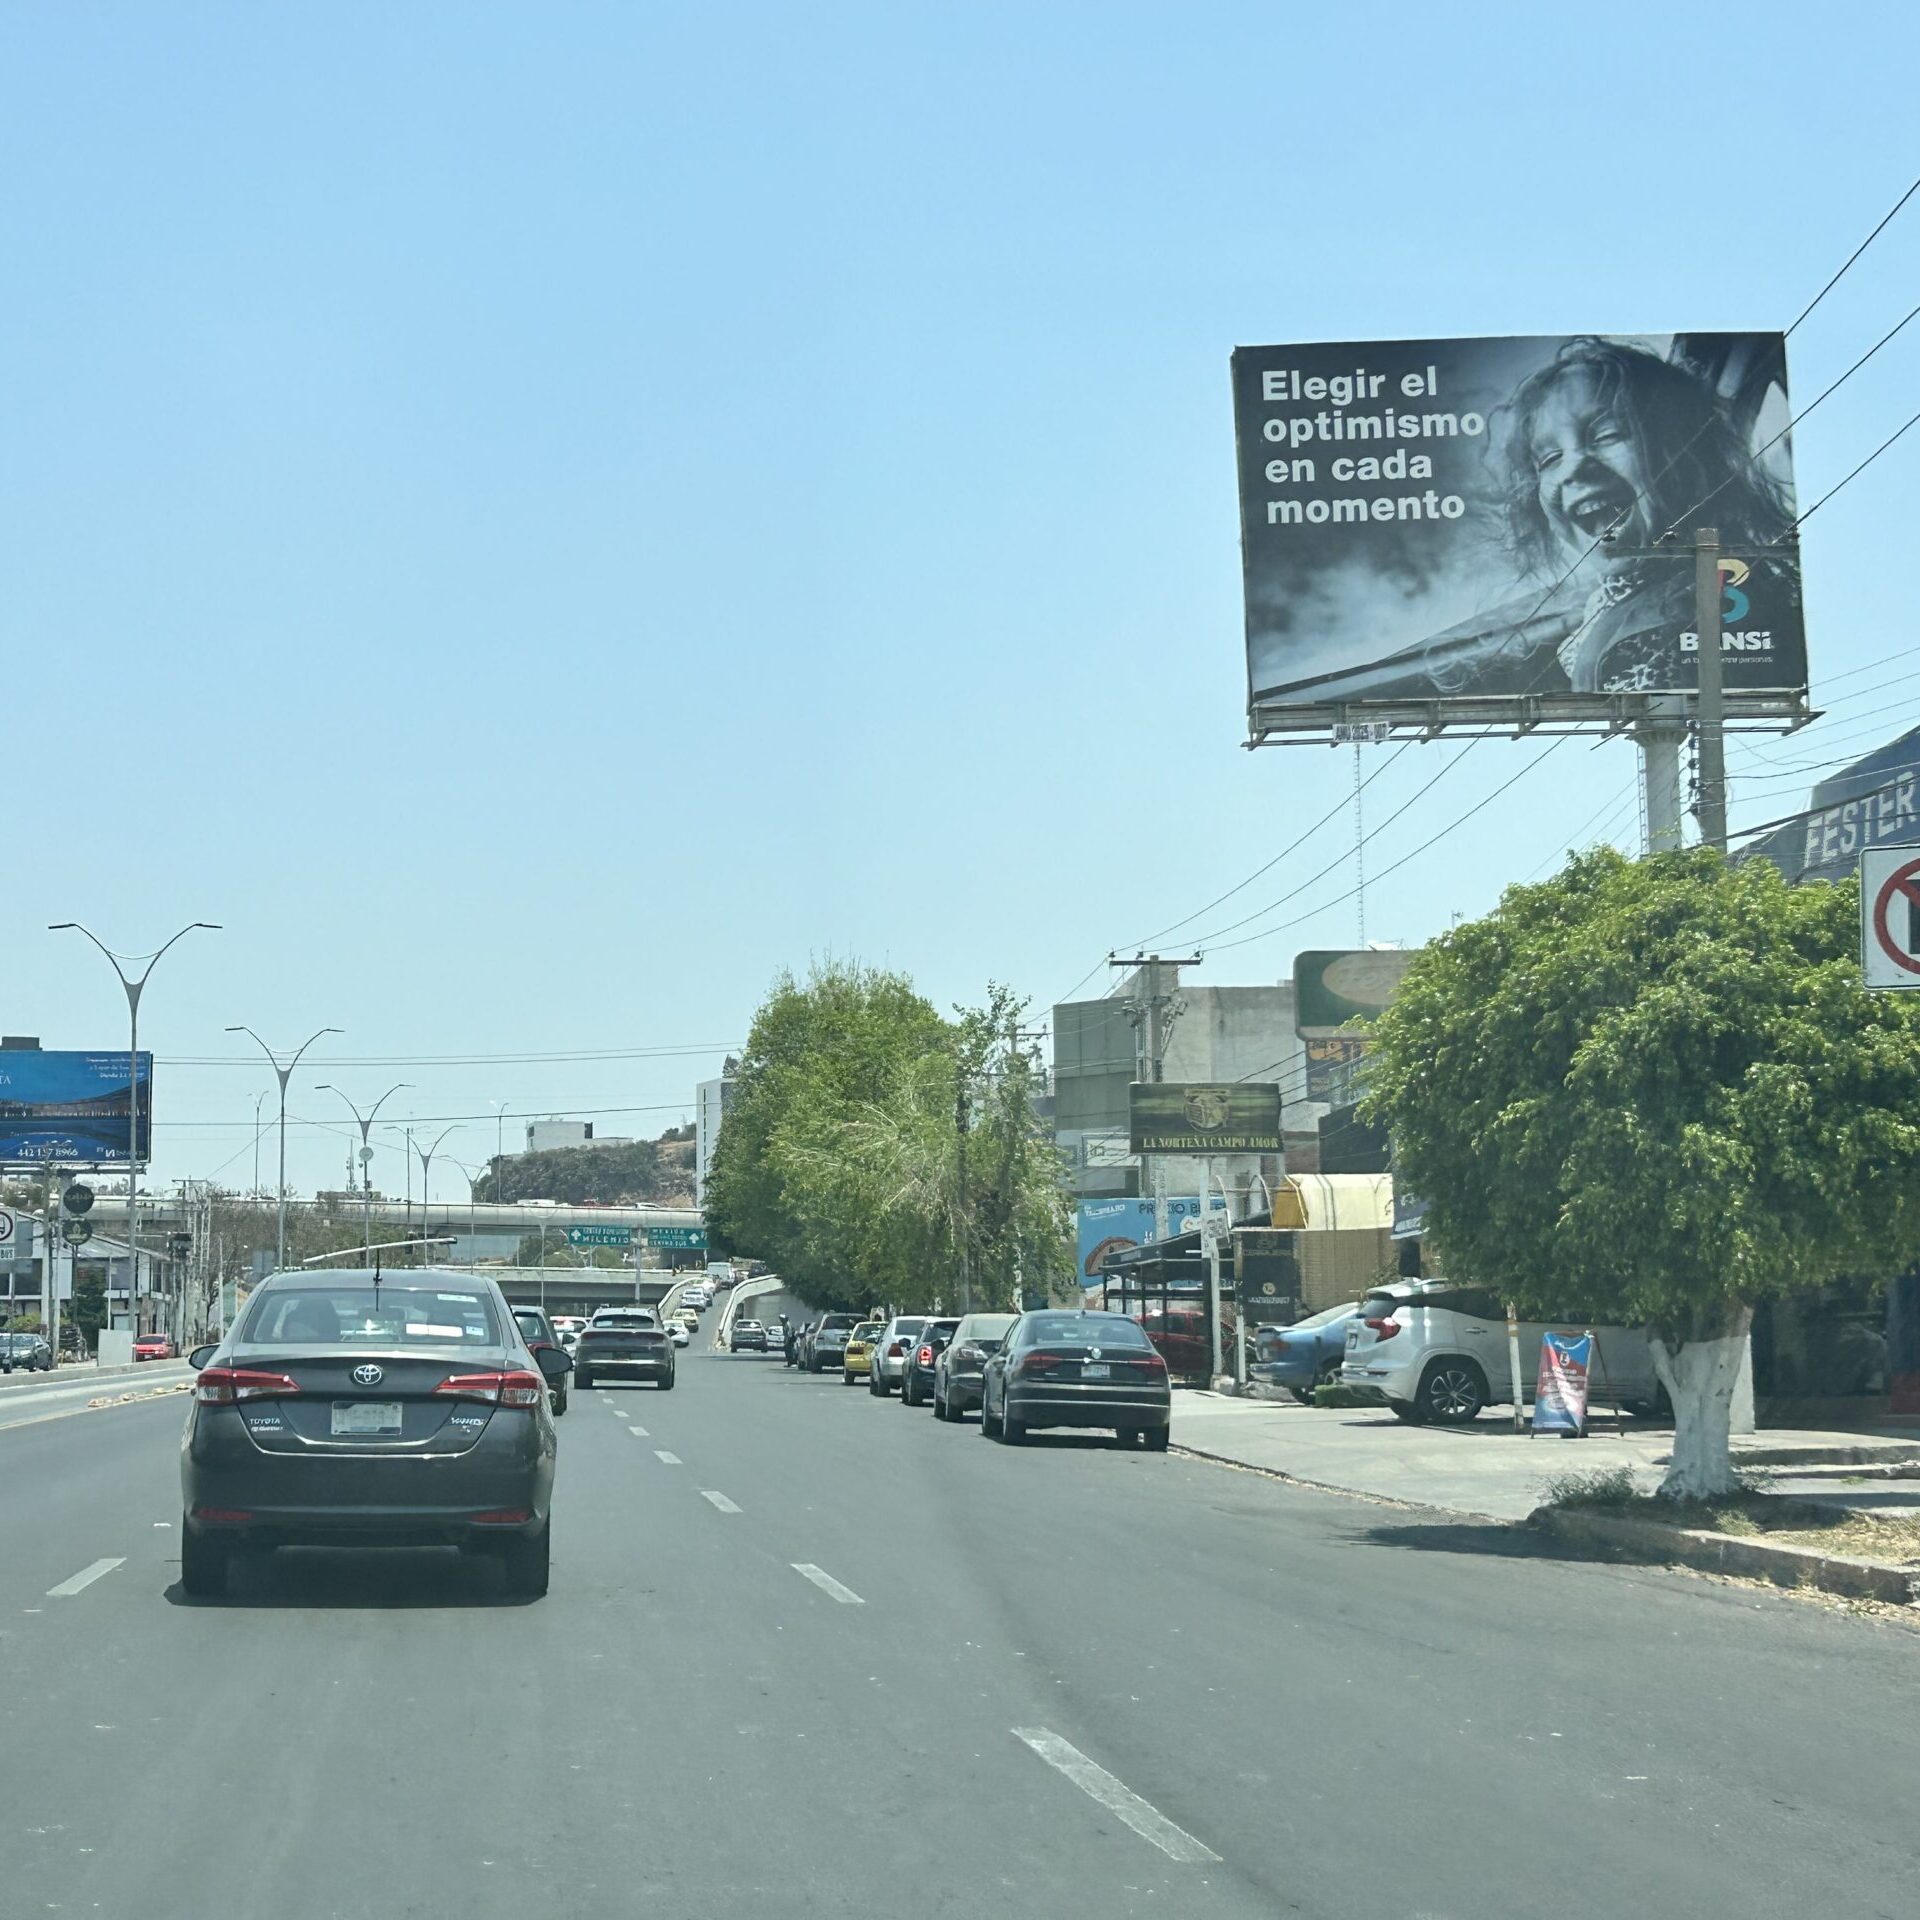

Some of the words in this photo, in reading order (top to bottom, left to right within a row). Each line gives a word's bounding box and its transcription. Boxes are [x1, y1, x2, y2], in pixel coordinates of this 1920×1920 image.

[1261, 367, 1386, 406] Elegir
[1400, 365, 1437, 397] el
[1262, 407, 1485, 448] optimismo
[1264, 457, 1315, 483] en
[1331, 448, 1433, 481] cada
[1267, 489, 1466, 524] momento
[1804, 770, 1918, 868] FESTER
[1143, 1137, 1155, 1148] LA
[1158, 1135, 1207, 1148] NORTEÑA
[1210, 1137, 1245, 1148] CAMPO
[250, 1417, 281, 1425] TOYOTA
